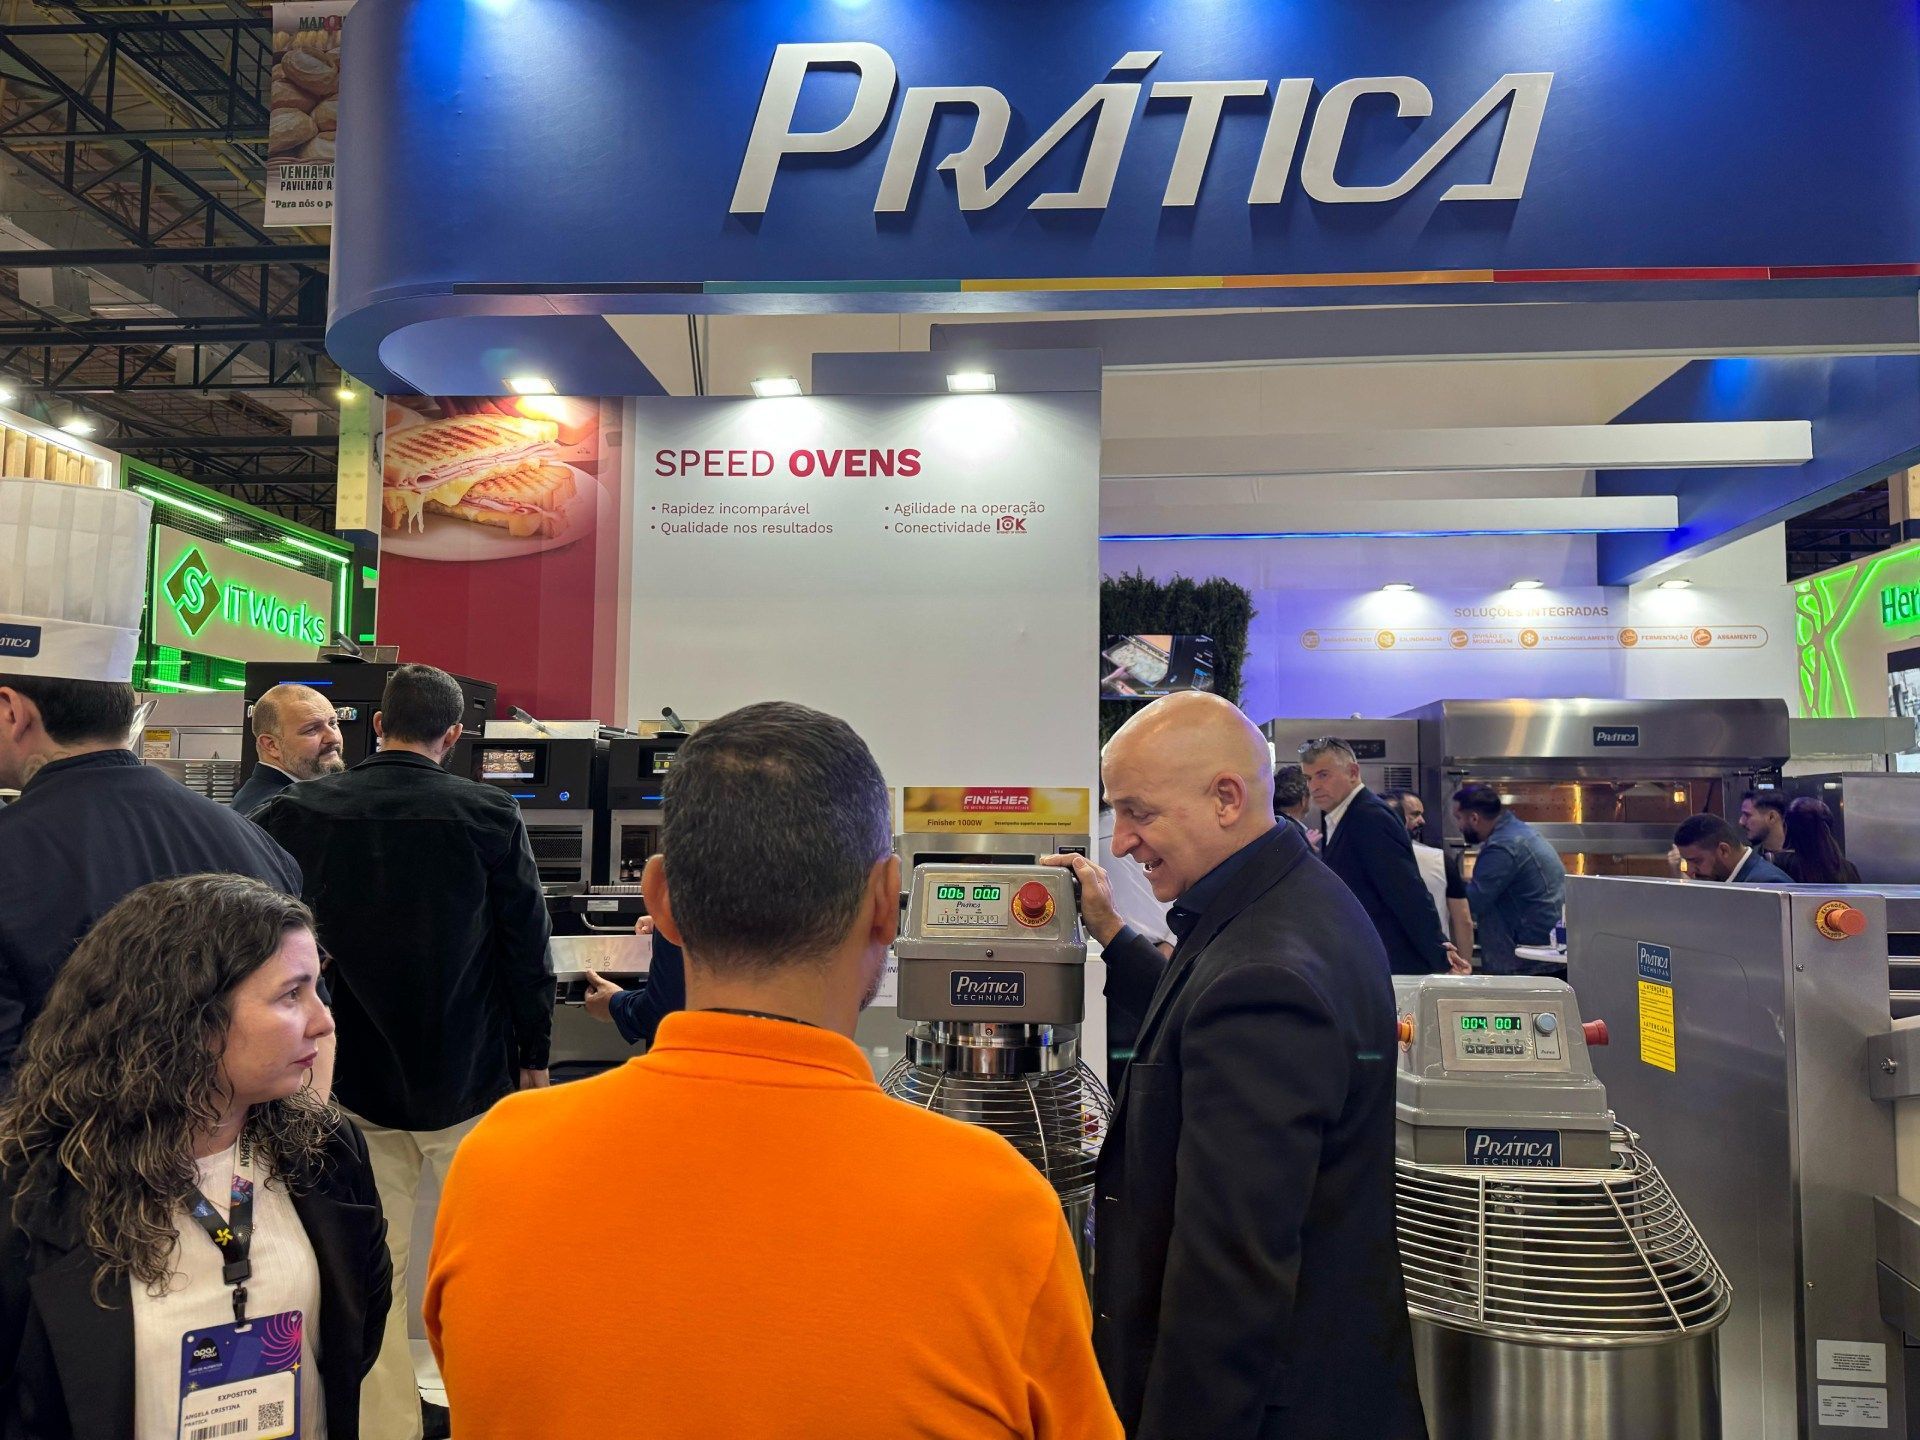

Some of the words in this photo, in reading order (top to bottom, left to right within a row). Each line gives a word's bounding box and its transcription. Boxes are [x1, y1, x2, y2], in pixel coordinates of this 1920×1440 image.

[729, 41, 1554, 213] PRÁTICA
[280, 165, 318, 179] VENHA
[280, 179, 323, 191] PAVILHÃO
[298, 199, 315, 208] nós
[654, 449, 775, 477] SPEED
[788, 448, 922, 478] OVENS
[661, 502, 715, 518] Rapidez
[719, 501, 810, 518] incomparável
[893, 502, 956, 517] Agilidade
[961, 504, 978, 514] na
[981, 500, 1046, 517] operação
[660, 521, 729, 536] Qualidade
[733, 524, 758, 534] nos
[762, 521, 834, 534] resultados
[894, 521, 991, 534] Conectividade
[223, 584, 248, 622] IT
[249, 590, 326, 646] Works
[1454, 605, 1523, 619] SOLUÇÕES
[963, 795, 1029, 805] FINISHER
[927, 818, 956, 827] Finisher
[957, 818, 983, 827] 1000W
[956, 975, 1019, 994] PRÁTICA
[956, 994, 1020, 1002] TECHNIPAN
[1473, 1134, 1553, 1157] PRÁTICA
[1473, 1157, 1554, 1167] TECHNIPAN
[217, 1388, 258, 1402] EXPOSITOR
[210, 1403, 241, 1415] CRISTINA
